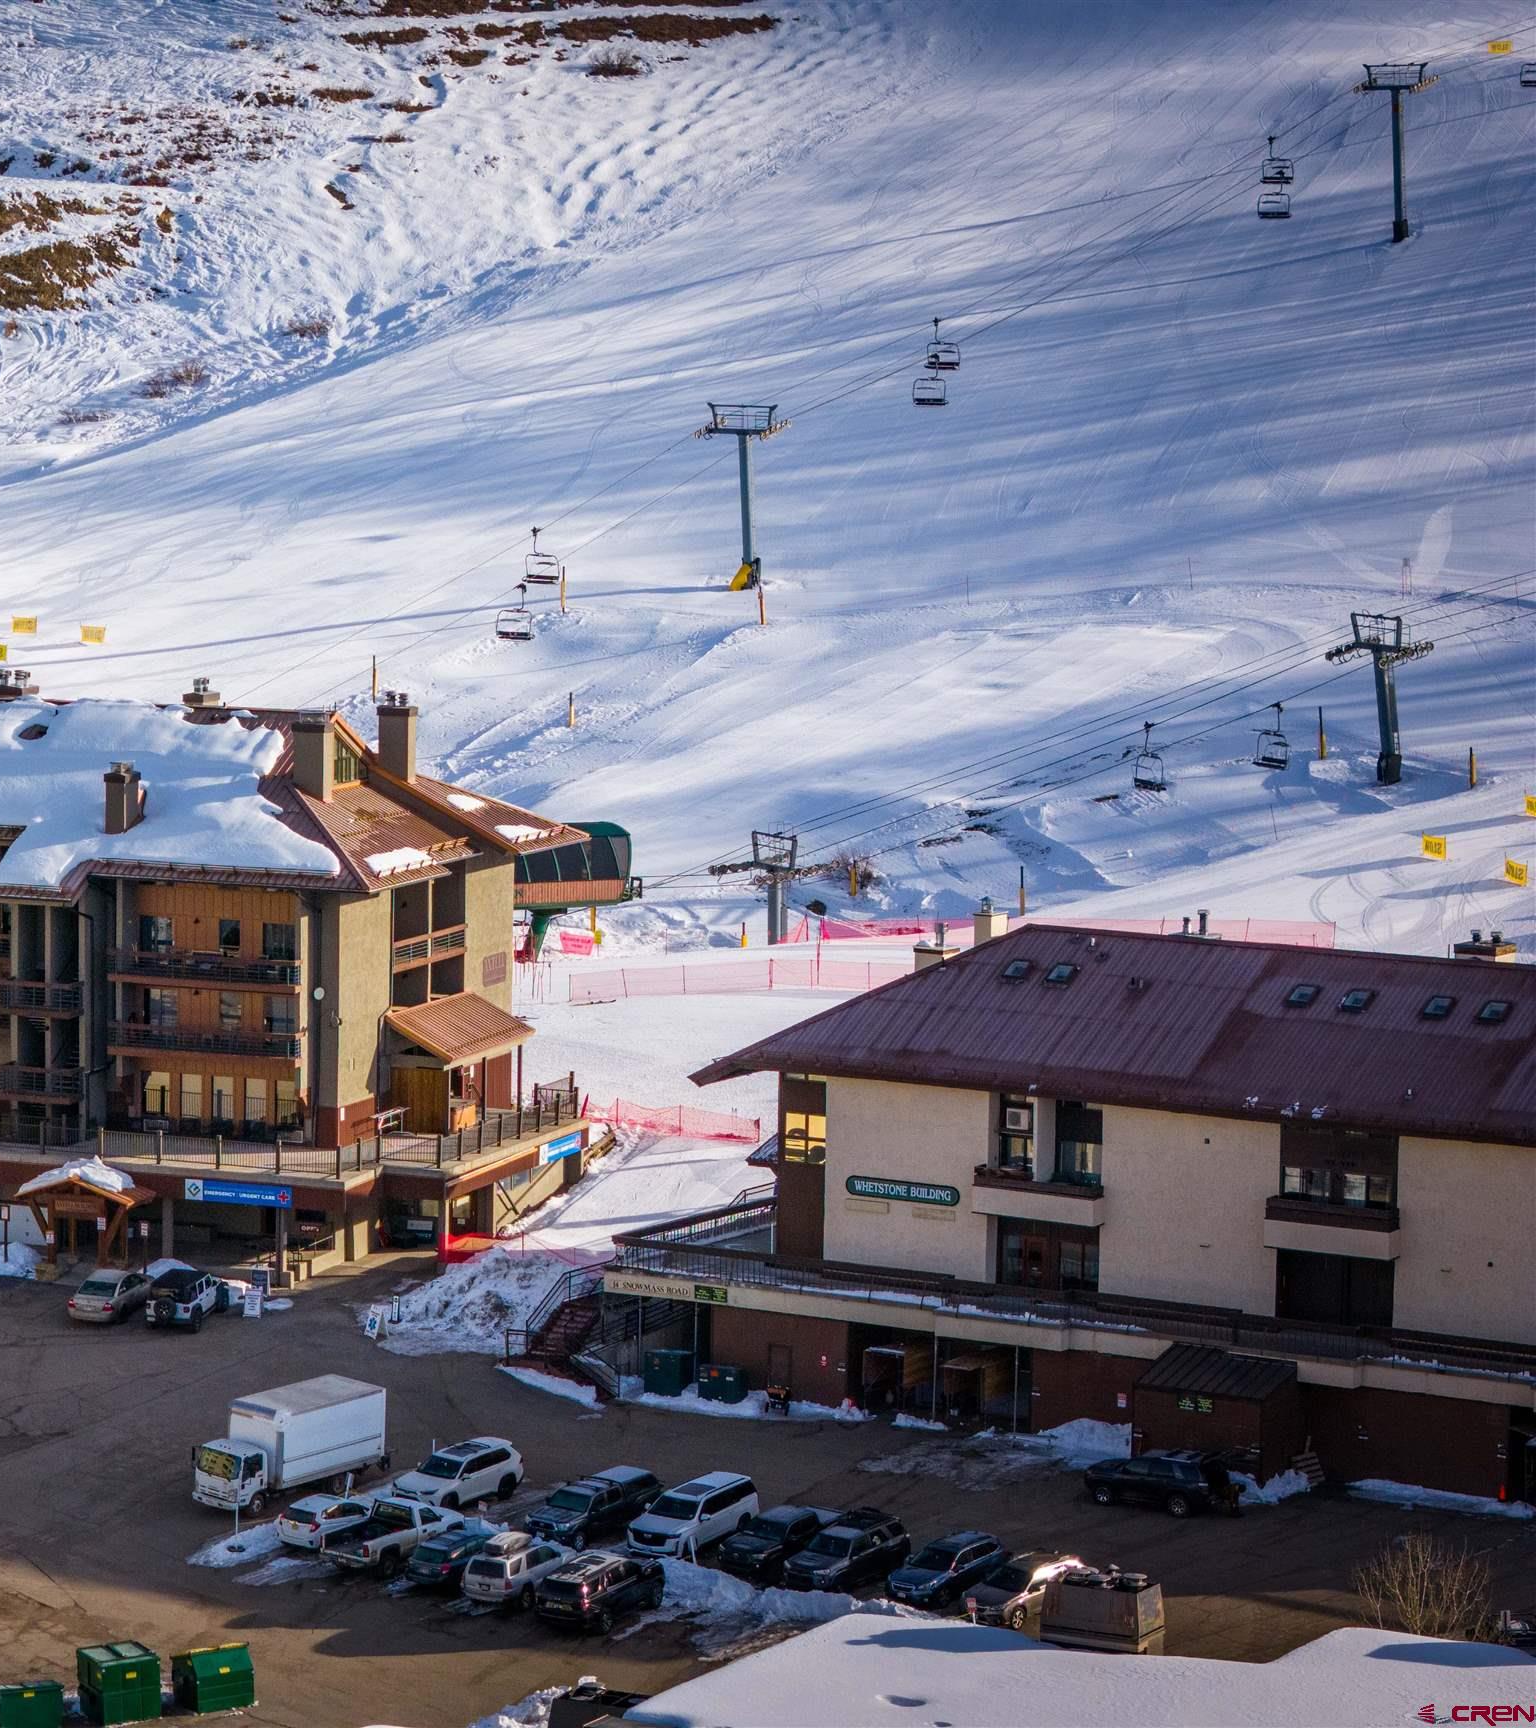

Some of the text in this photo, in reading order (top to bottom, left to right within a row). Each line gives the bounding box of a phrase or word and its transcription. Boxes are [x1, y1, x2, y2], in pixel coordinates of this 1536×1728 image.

[204, 1189, 235, 1198] EMERGENCY
[239, 1191, 260, 1200] URGENT
[854, 1180, 951, 1201] WHETSTONE BUILDING
[622, 1281, 665, 1295] SNOWMASS
[666, 1286, 689, 1296] ROAD
